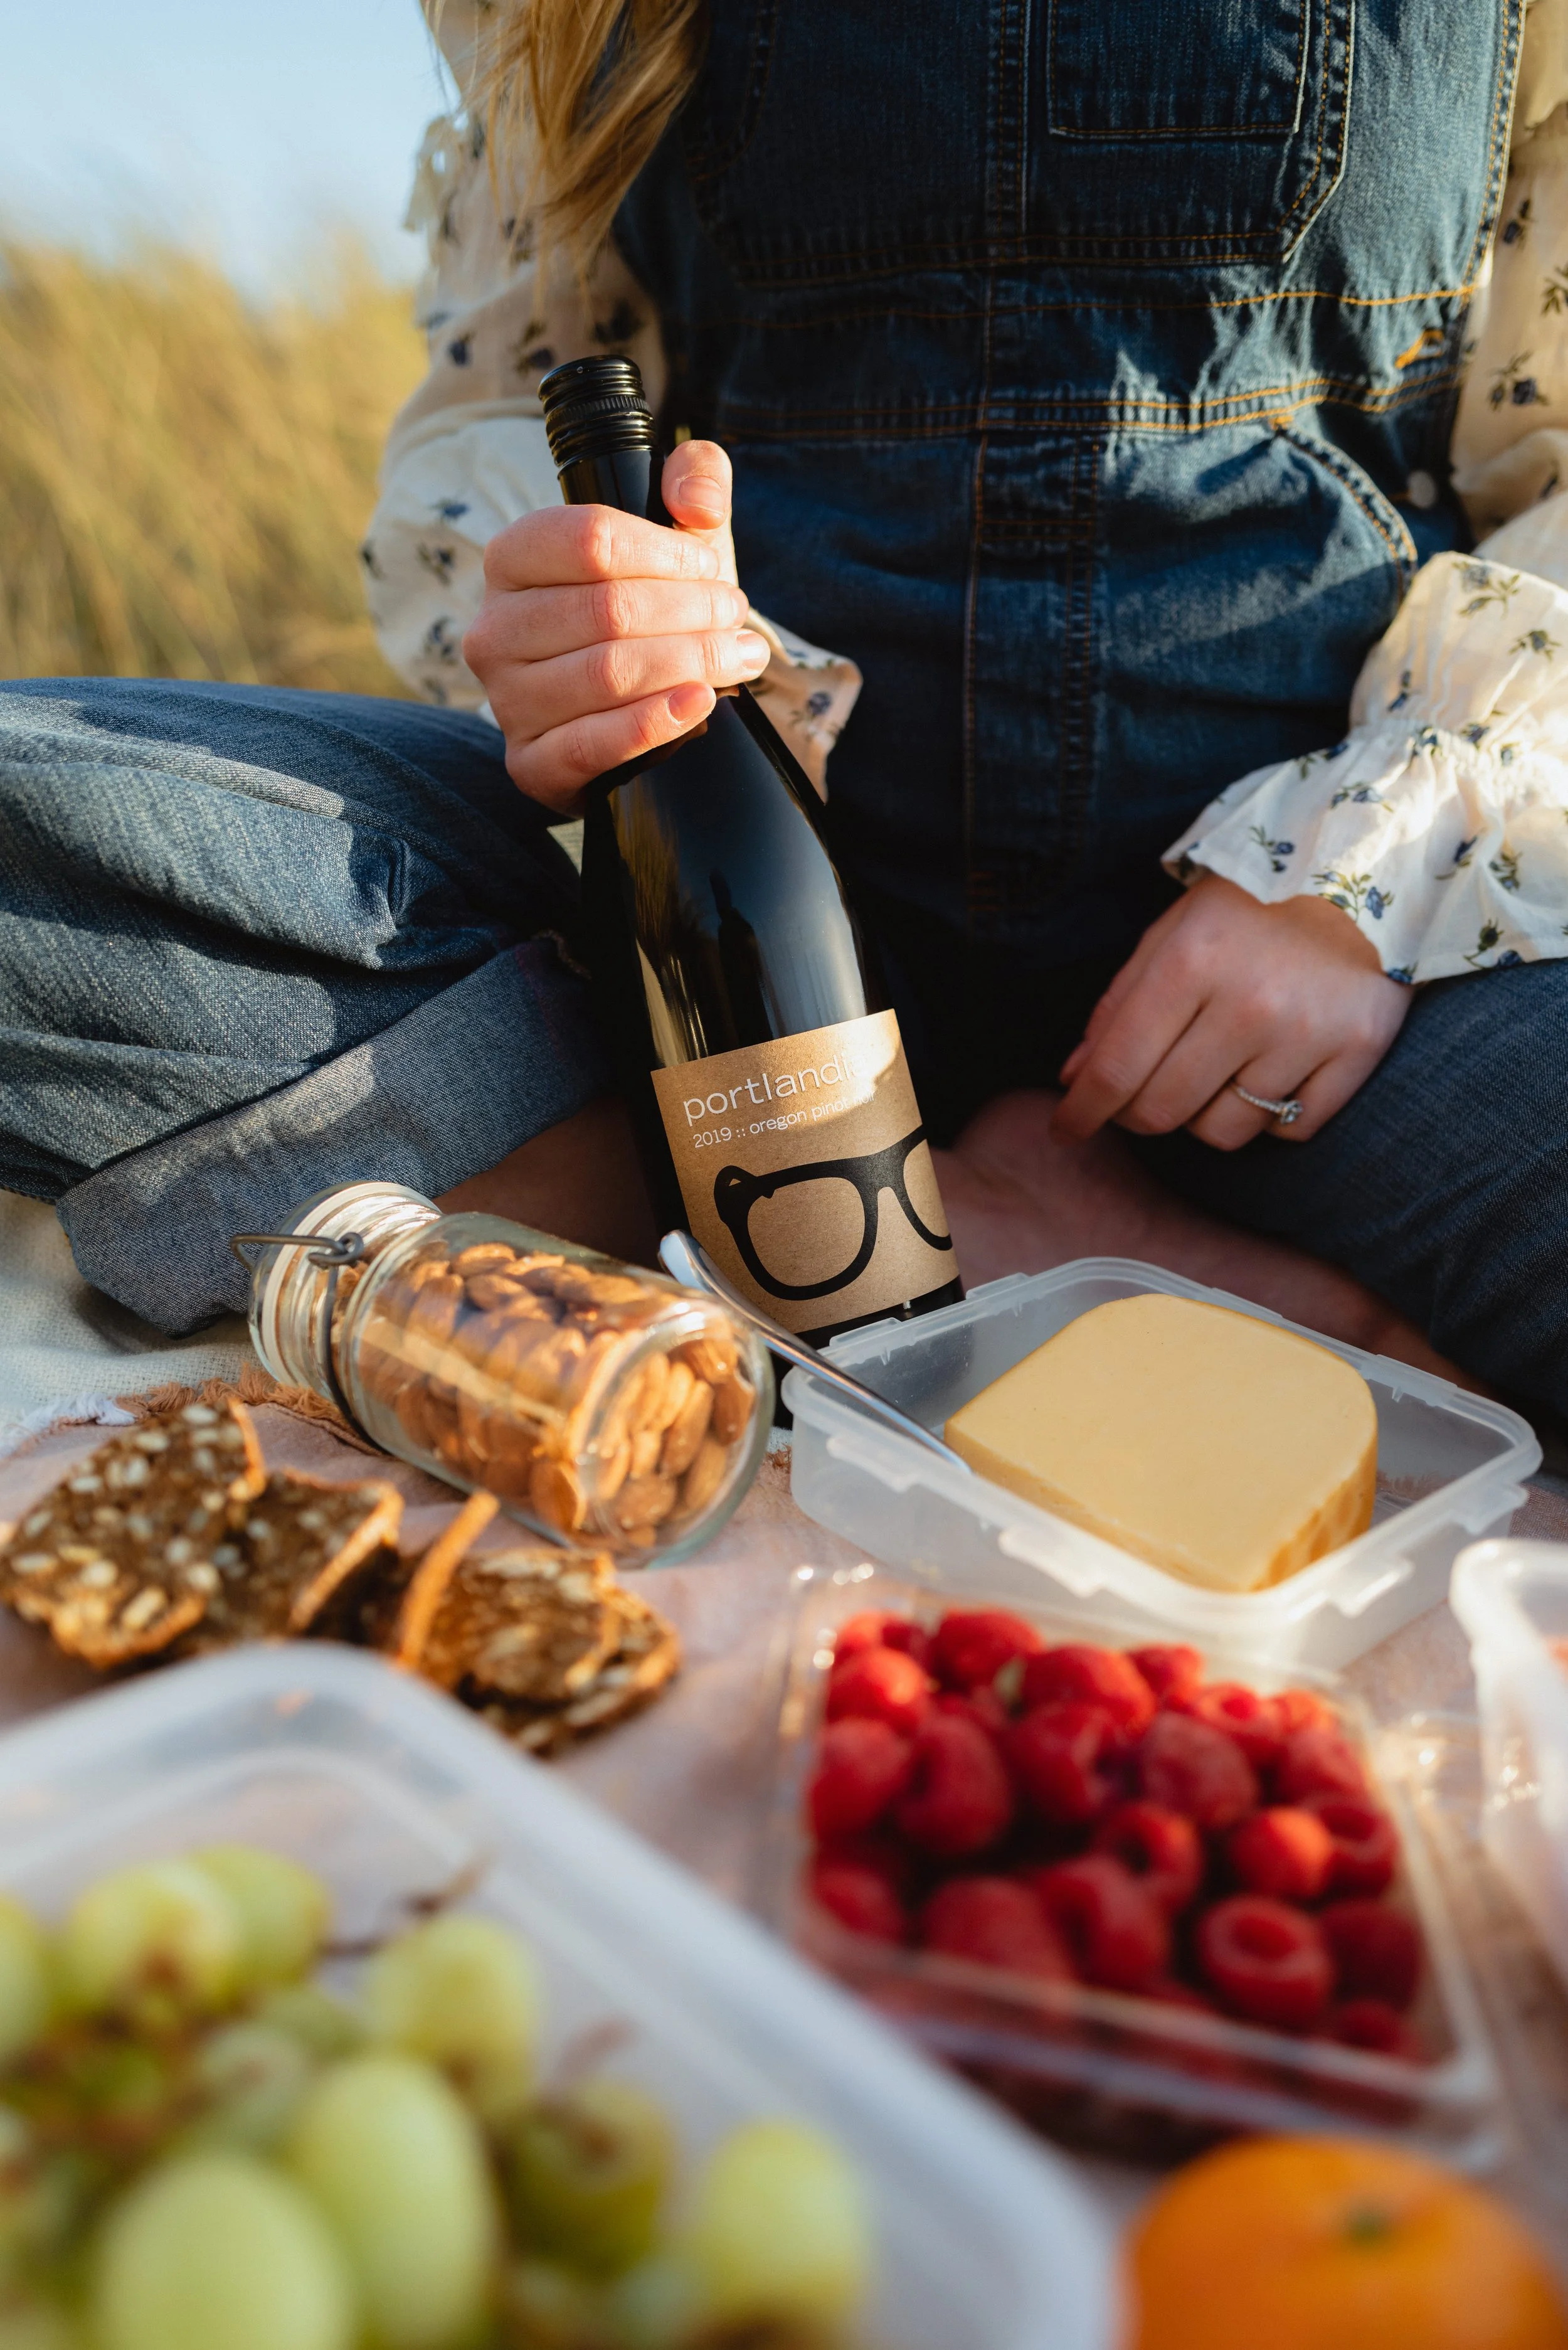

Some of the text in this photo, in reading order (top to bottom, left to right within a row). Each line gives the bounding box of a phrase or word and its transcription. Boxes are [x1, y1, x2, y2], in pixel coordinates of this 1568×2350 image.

[683, 1052, 869, 1127] portlandi
[692, 1127, 732, 1148] 2019
[750, 1110, 807, 1134] oregon
[810, 1097, 850, 1122] pinot
